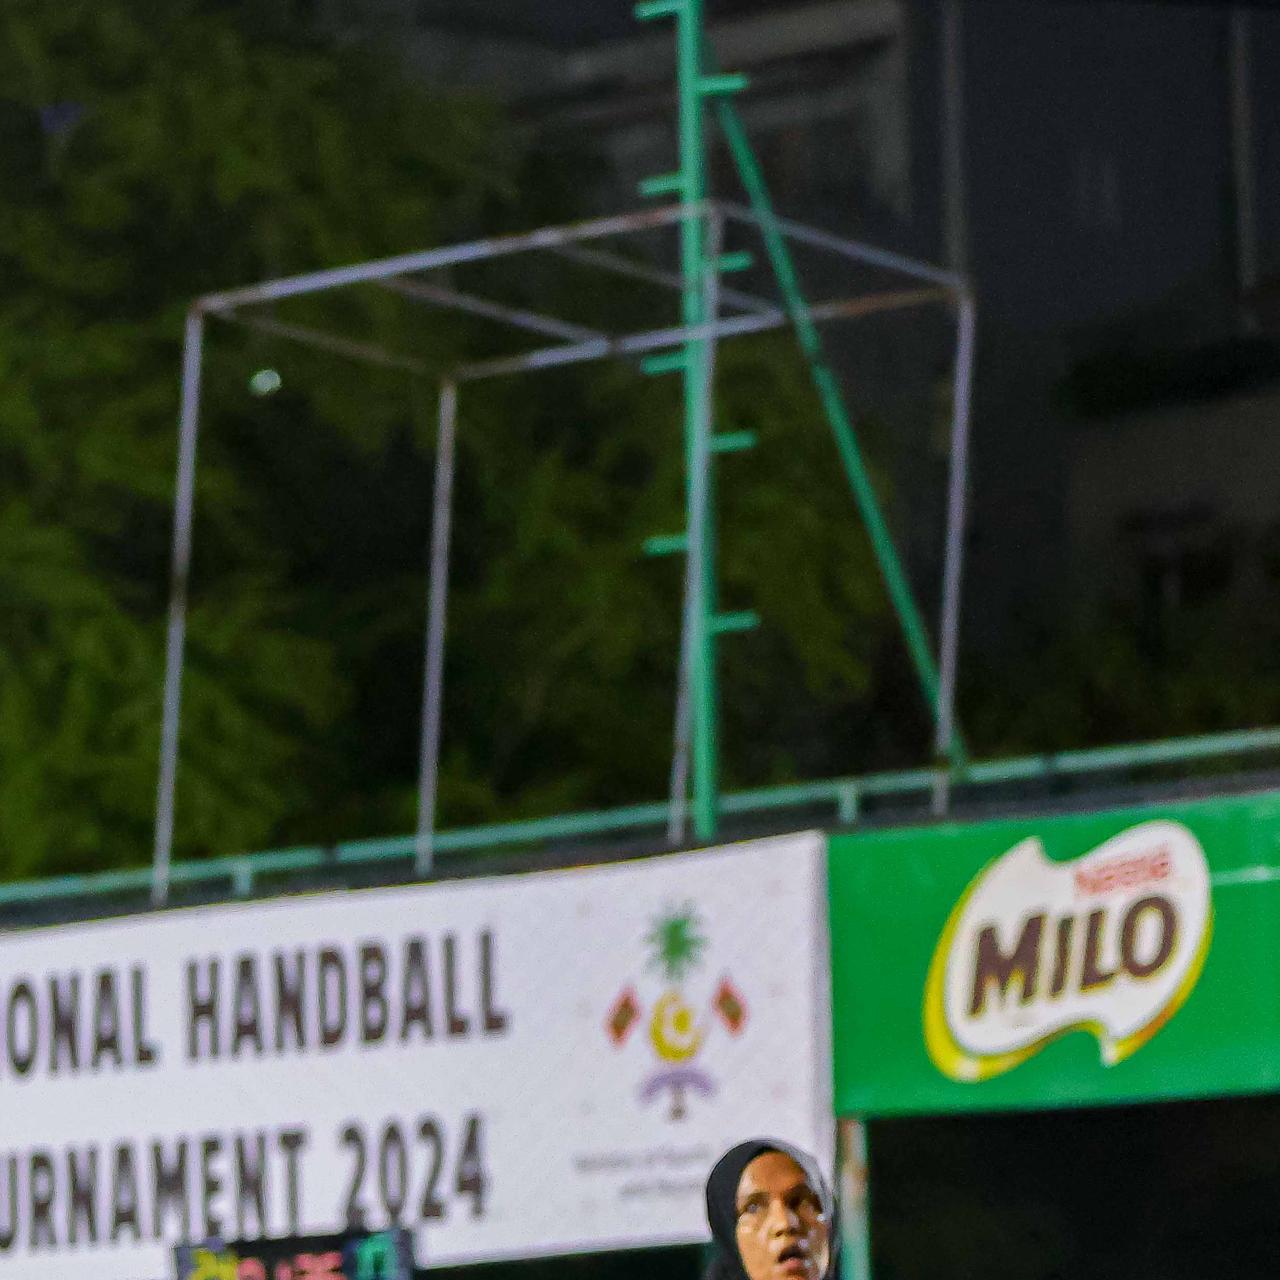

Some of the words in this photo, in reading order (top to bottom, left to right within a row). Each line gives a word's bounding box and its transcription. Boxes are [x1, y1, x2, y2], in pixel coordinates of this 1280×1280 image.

[185, 927, 510, 1062] HANDBALL
[966, 896, 1178, 1017] MILO
[340, 1110, 488, 1229] 2024
